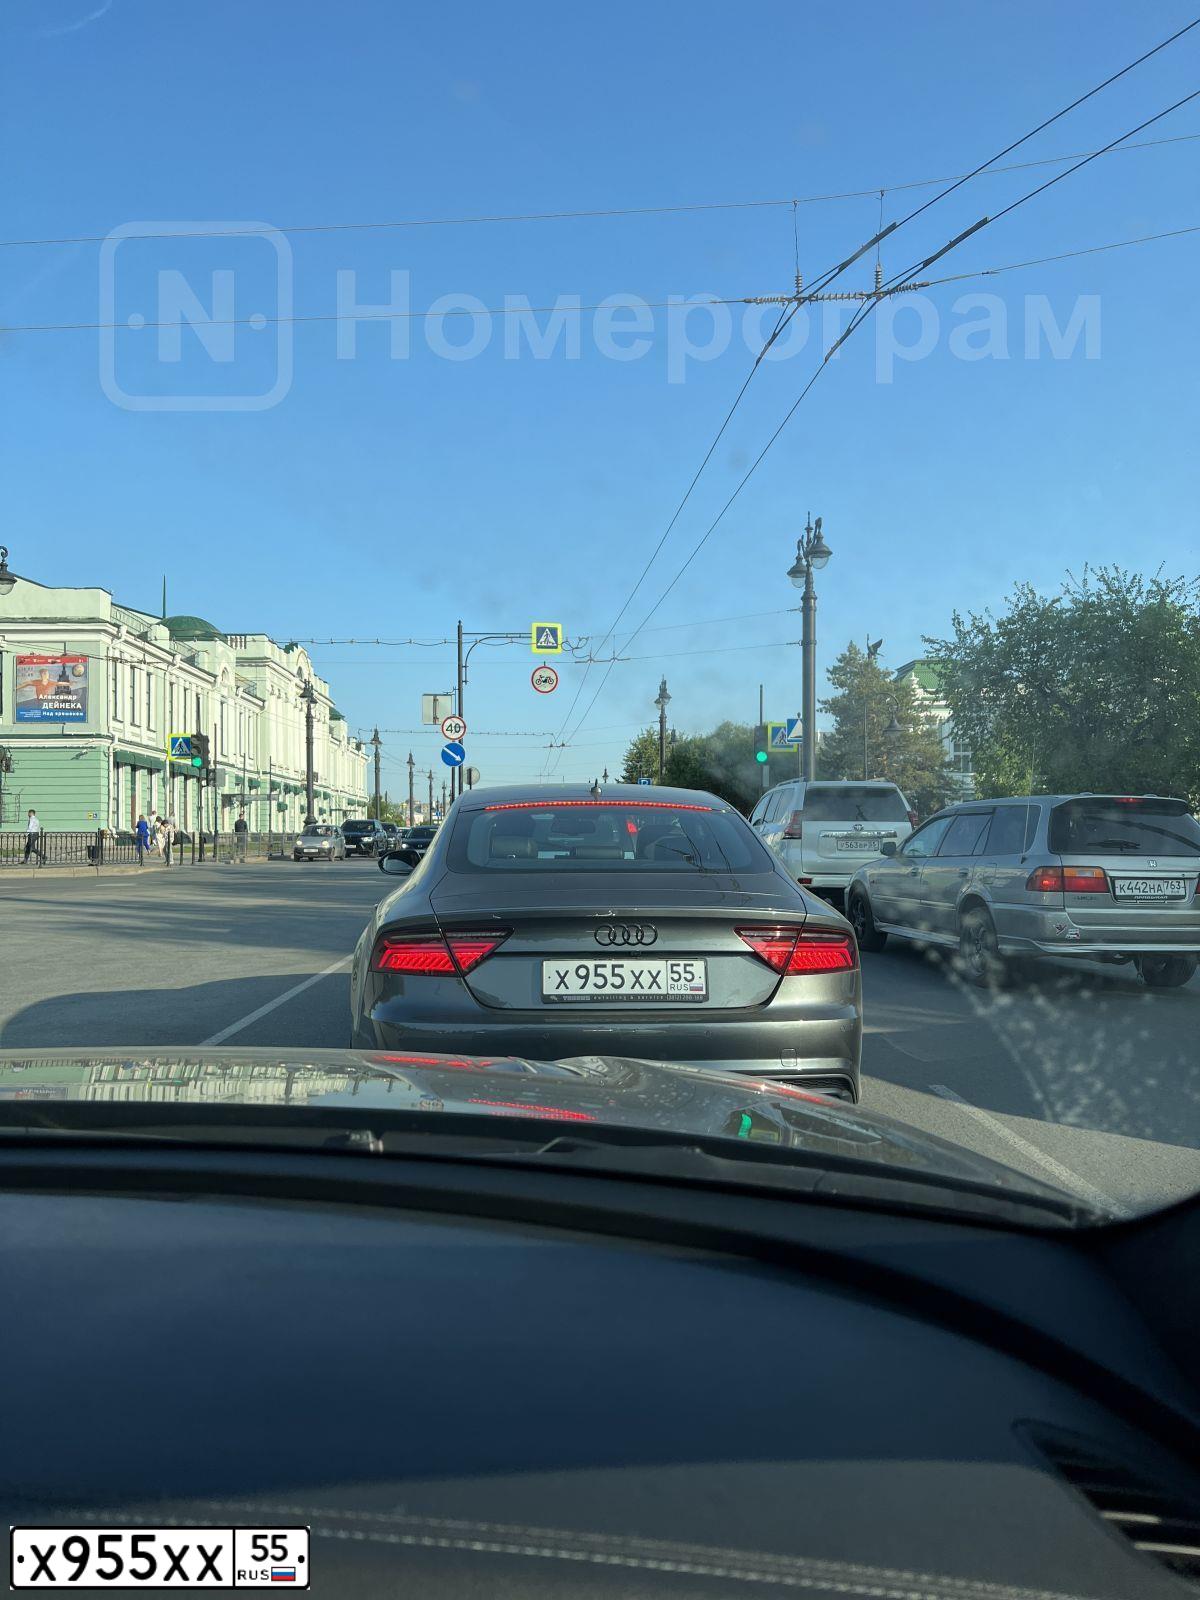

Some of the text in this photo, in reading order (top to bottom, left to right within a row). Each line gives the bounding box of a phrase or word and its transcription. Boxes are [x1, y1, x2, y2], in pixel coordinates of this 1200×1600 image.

[42, 701, 82, 709] ДЕЙНЕКА
[446, 722, 461, 734] 40
[1119, 881, 1181, 893] К442НА 763
[555, 963, 695, 990] Х955ХХ 55
[669, 983, 689, 991] RUS
